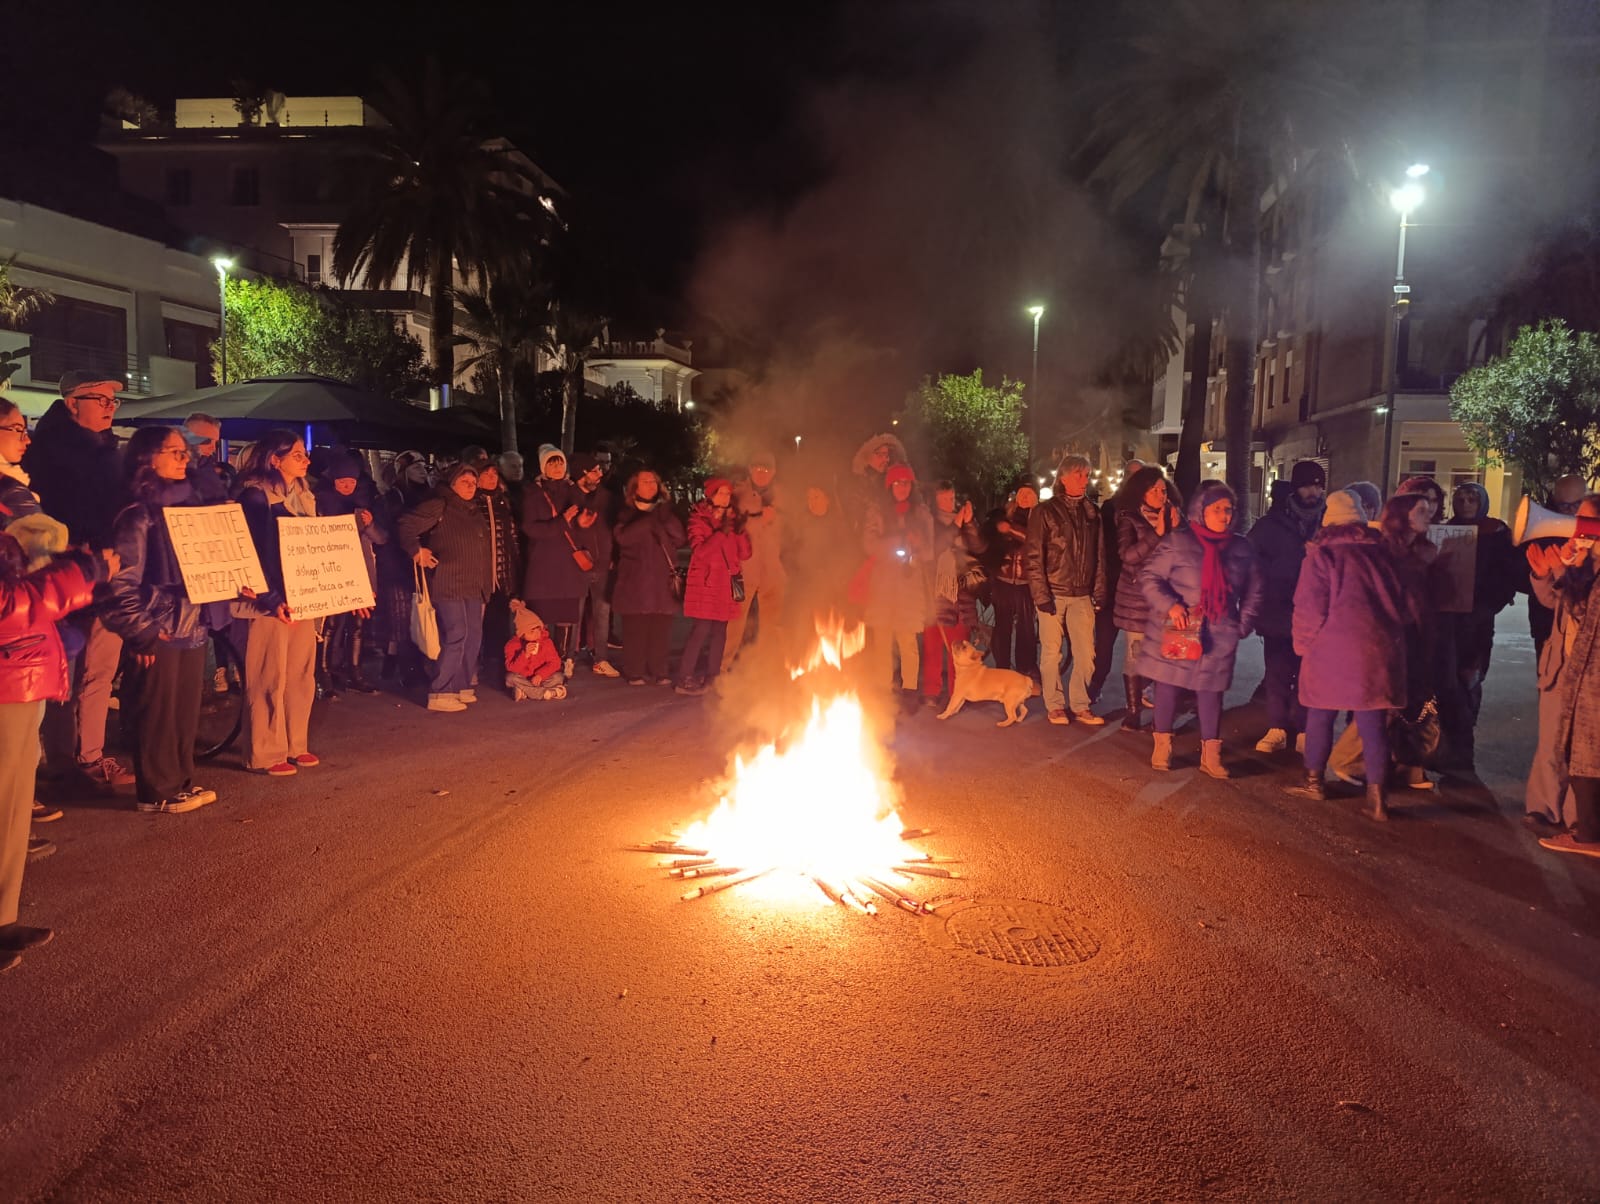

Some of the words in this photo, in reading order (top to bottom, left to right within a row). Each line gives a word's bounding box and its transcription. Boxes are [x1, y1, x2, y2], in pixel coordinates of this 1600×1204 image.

[169, 512, 194, 537] PER
[195, 509, 245, 536] TUTTE
[305, 524, 320, 536] sono
[175, 542, 193, 565] LE
[193, 537, 251, 564] SORELLE
[306, 541, 326, 555] torno
[321, 561, 342, 574] tutto
[186, 566, 260, 595] AMMAZZATE
[318, 580, 337, 592] tocca
[308, 601, 329, 612] essere
